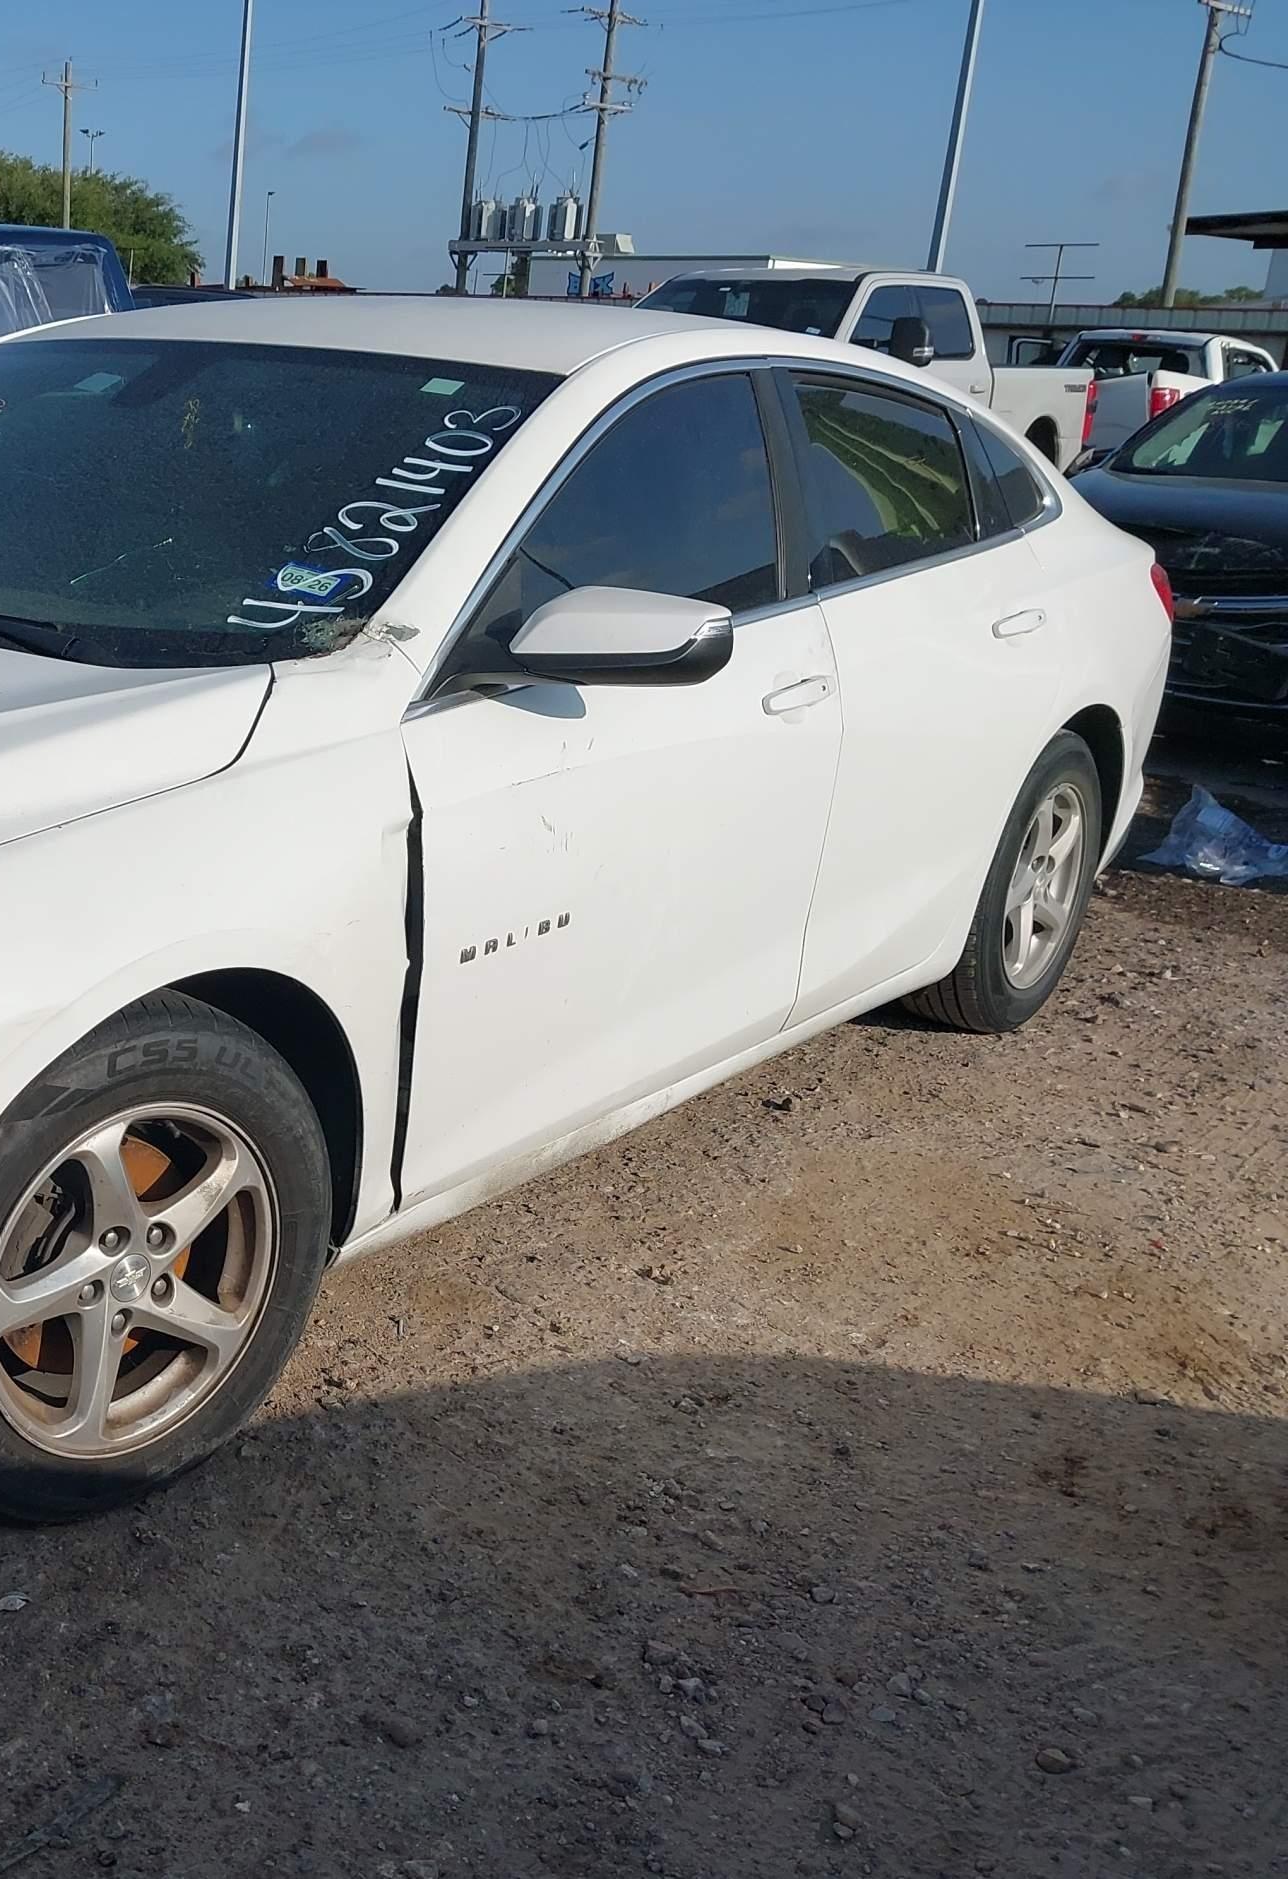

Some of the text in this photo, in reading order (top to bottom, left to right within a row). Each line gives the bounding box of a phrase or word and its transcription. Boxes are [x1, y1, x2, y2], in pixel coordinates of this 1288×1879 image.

[227, 405, 522, 629] 45821403
[459, 911, 571, 965] MALIBU
[106, 1038, 257, 1081] CS5 UL
